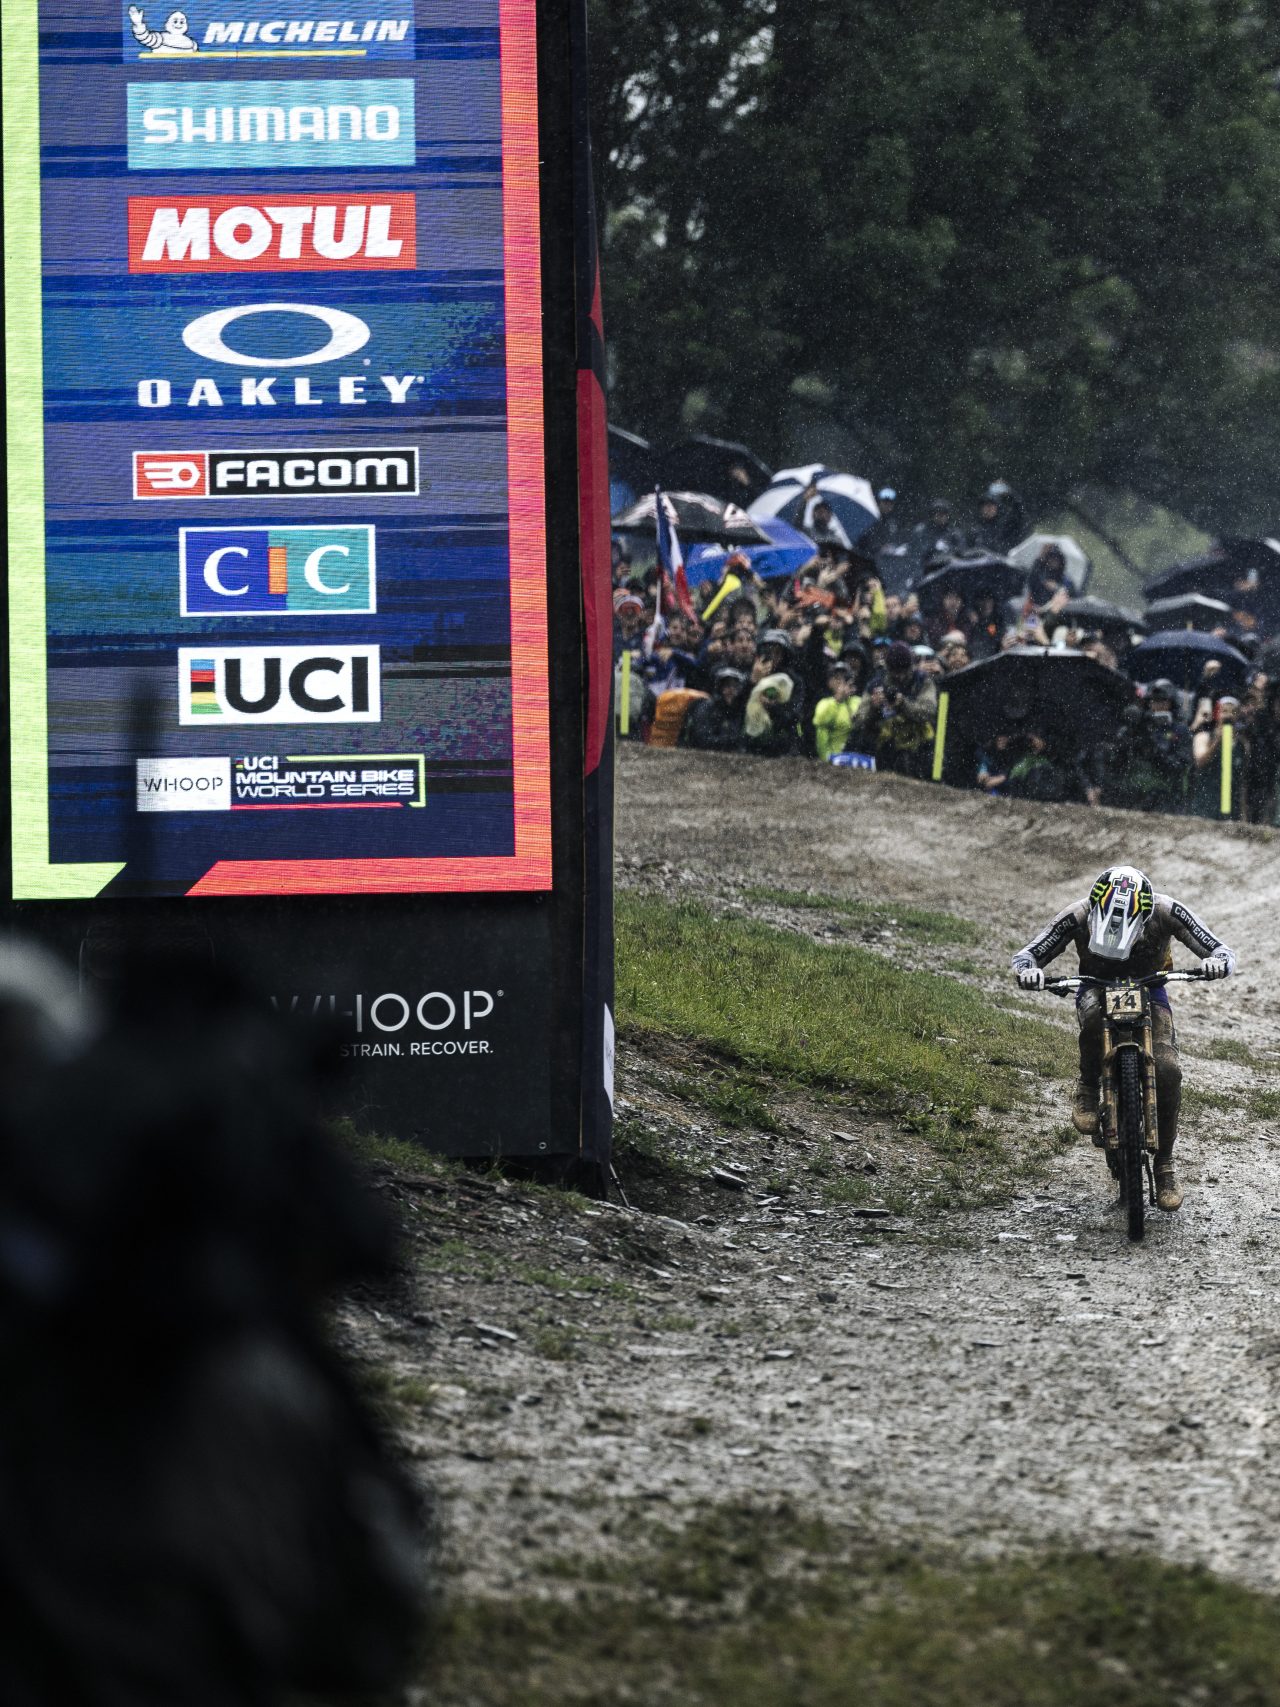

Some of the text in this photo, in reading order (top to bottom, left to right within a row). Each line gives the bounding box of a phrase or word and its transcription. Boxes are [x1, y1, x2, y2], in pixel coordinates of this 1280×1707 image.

[203, 20, 409, 44] MICHELIN
[143, 105, 399, 143] SHIMANO
[142, 205, 403, 260] MOTUL
[137, 376, 419, 408] OAKLEY
[216, 457, 408, 488] FACOM
[203, 546, 350, 596] CIC
[223, 656, 370, 713] UCI
[243, 756, 278, 770] UCI
[144, 776, 223, 792] WHOOP
[236, 769, 414, 785] MOUNTAIN BIKE
[236, 783, 414, 798] WORLD SERIES
[1112, 994, 1137, 1009] 14
[340, 1041, 494, 1057] STRAIN. RECOVER.
